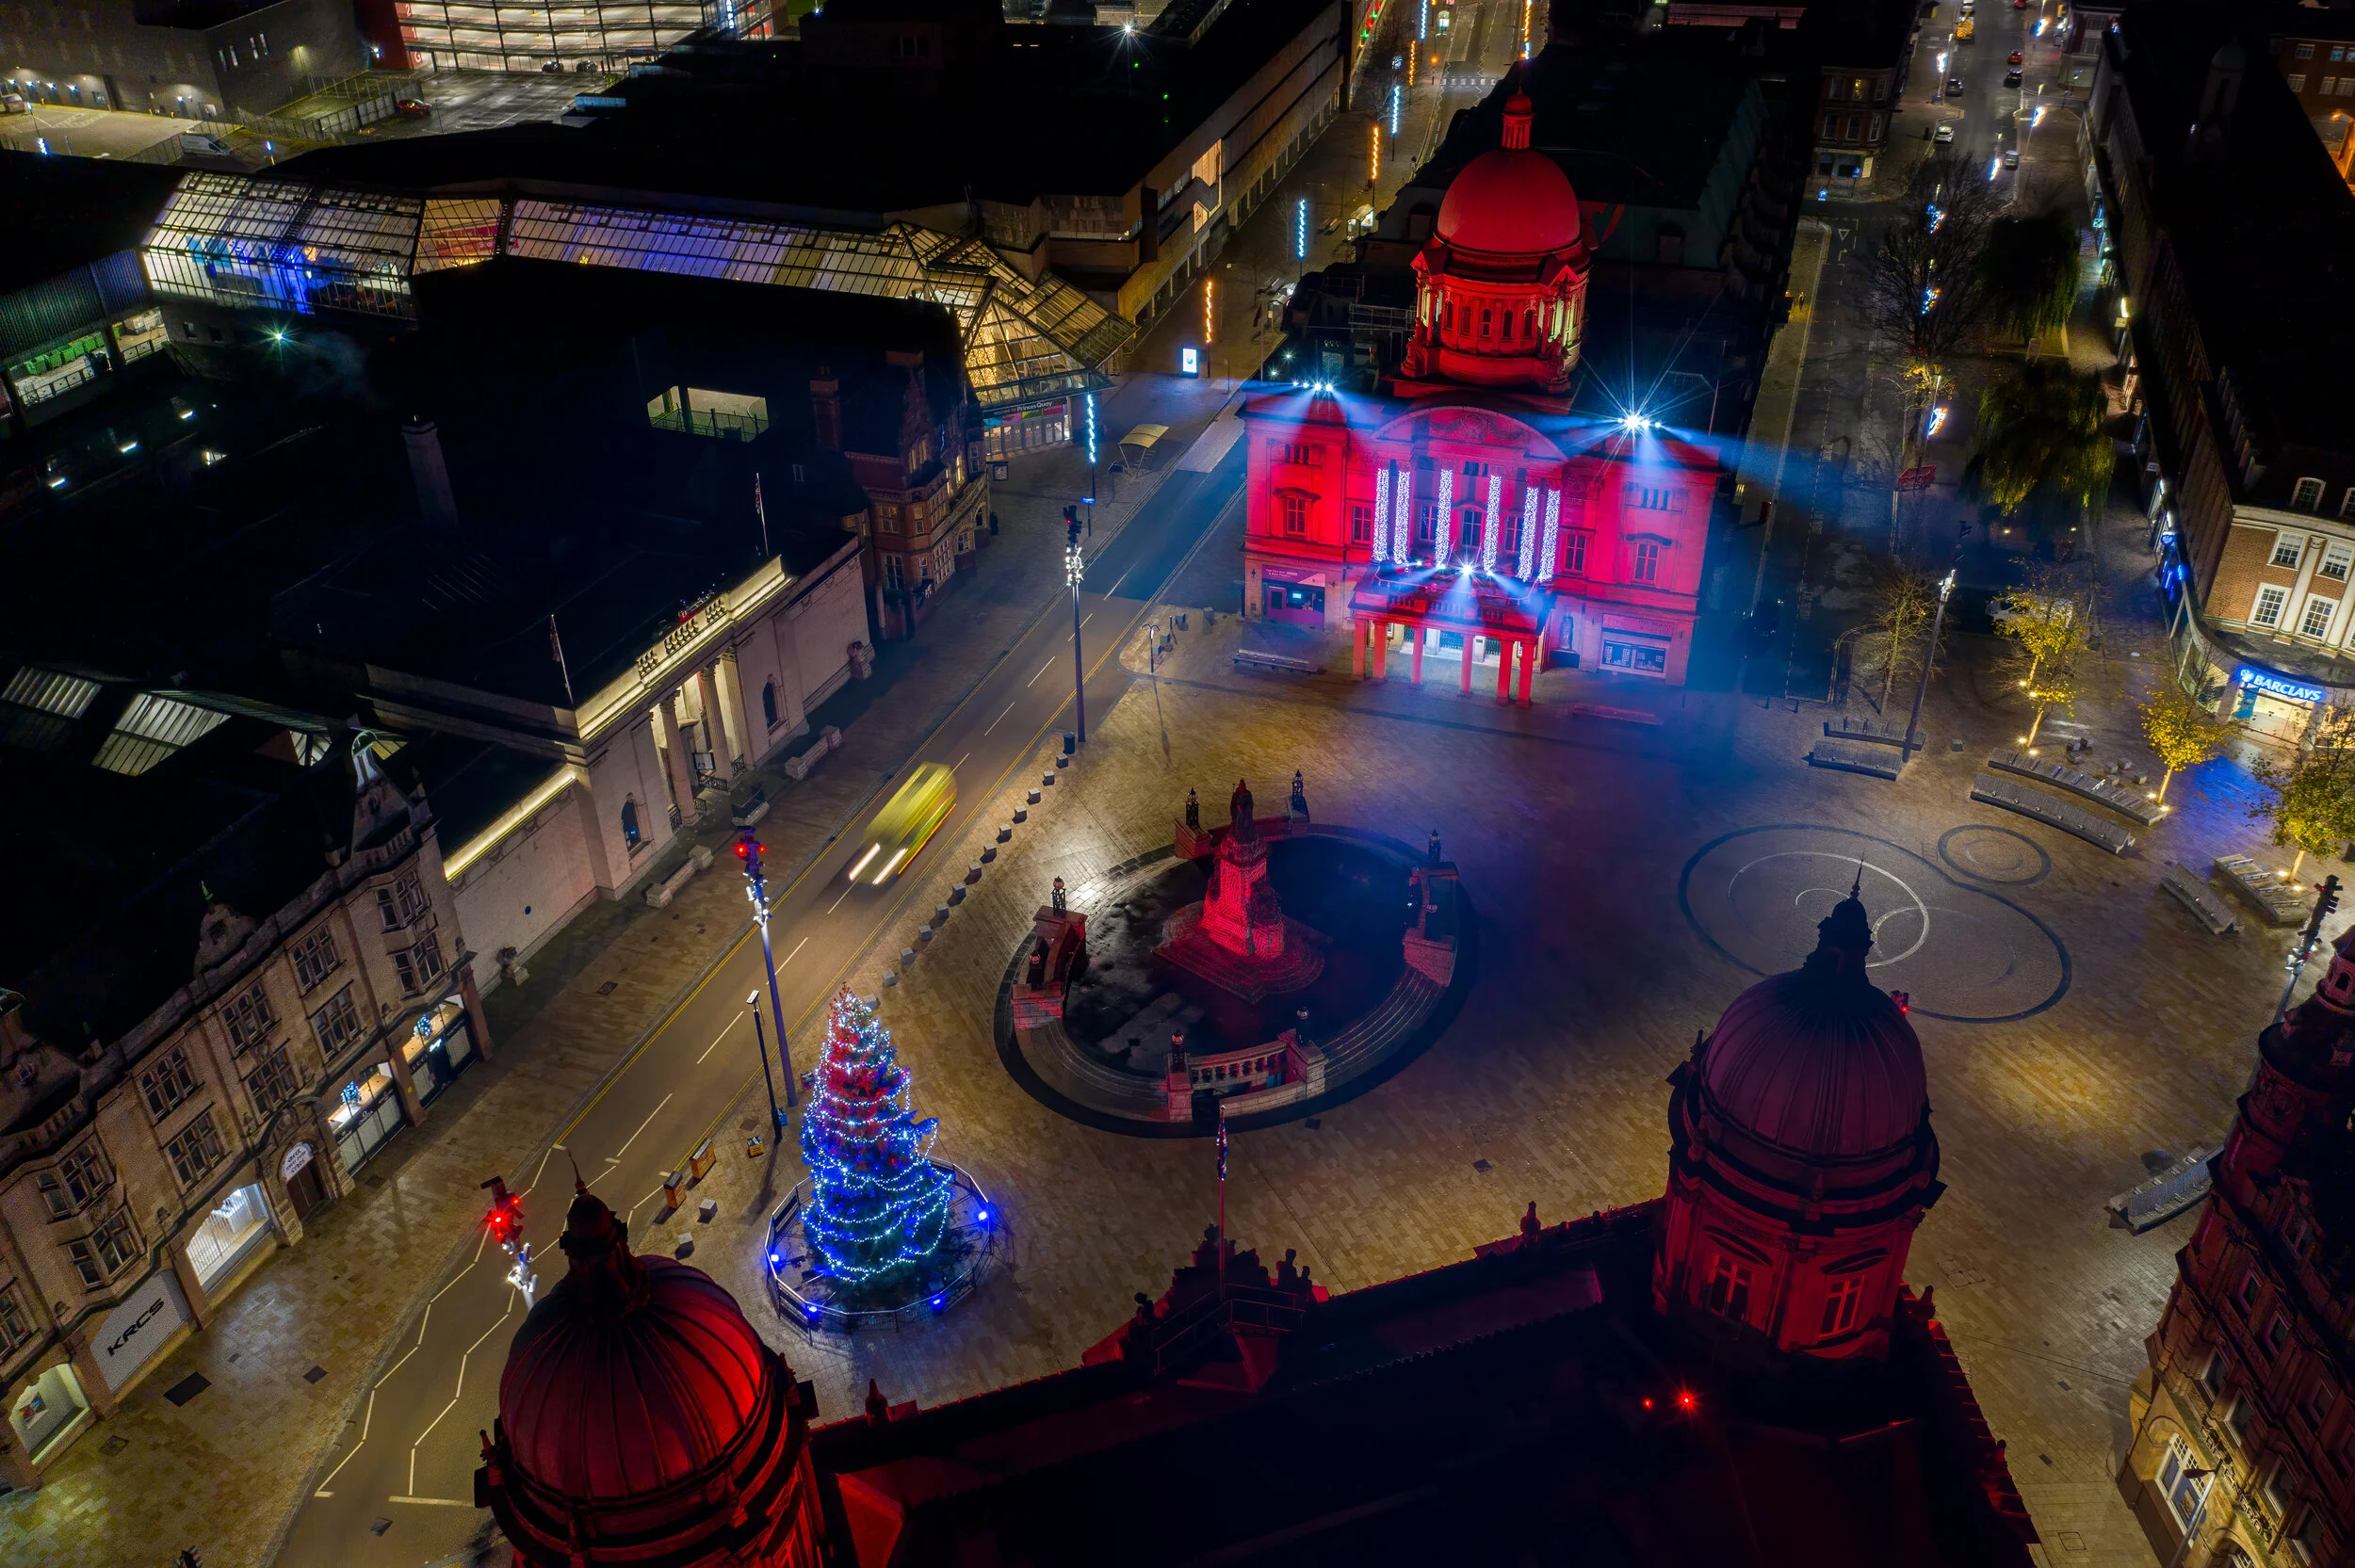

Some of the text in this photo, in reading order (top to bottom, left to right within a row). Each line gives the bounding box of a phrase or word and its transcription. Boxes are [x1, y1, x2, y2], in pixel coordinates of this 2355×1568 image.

[405, 3, 412, 17] 2
[414, 51, 422, 63] G
[1016, 403, 1037, 412] Princes
[2253, 674, 2322, 702] BARCLAYS
[107, 1297, 165, 1357] KRCS
